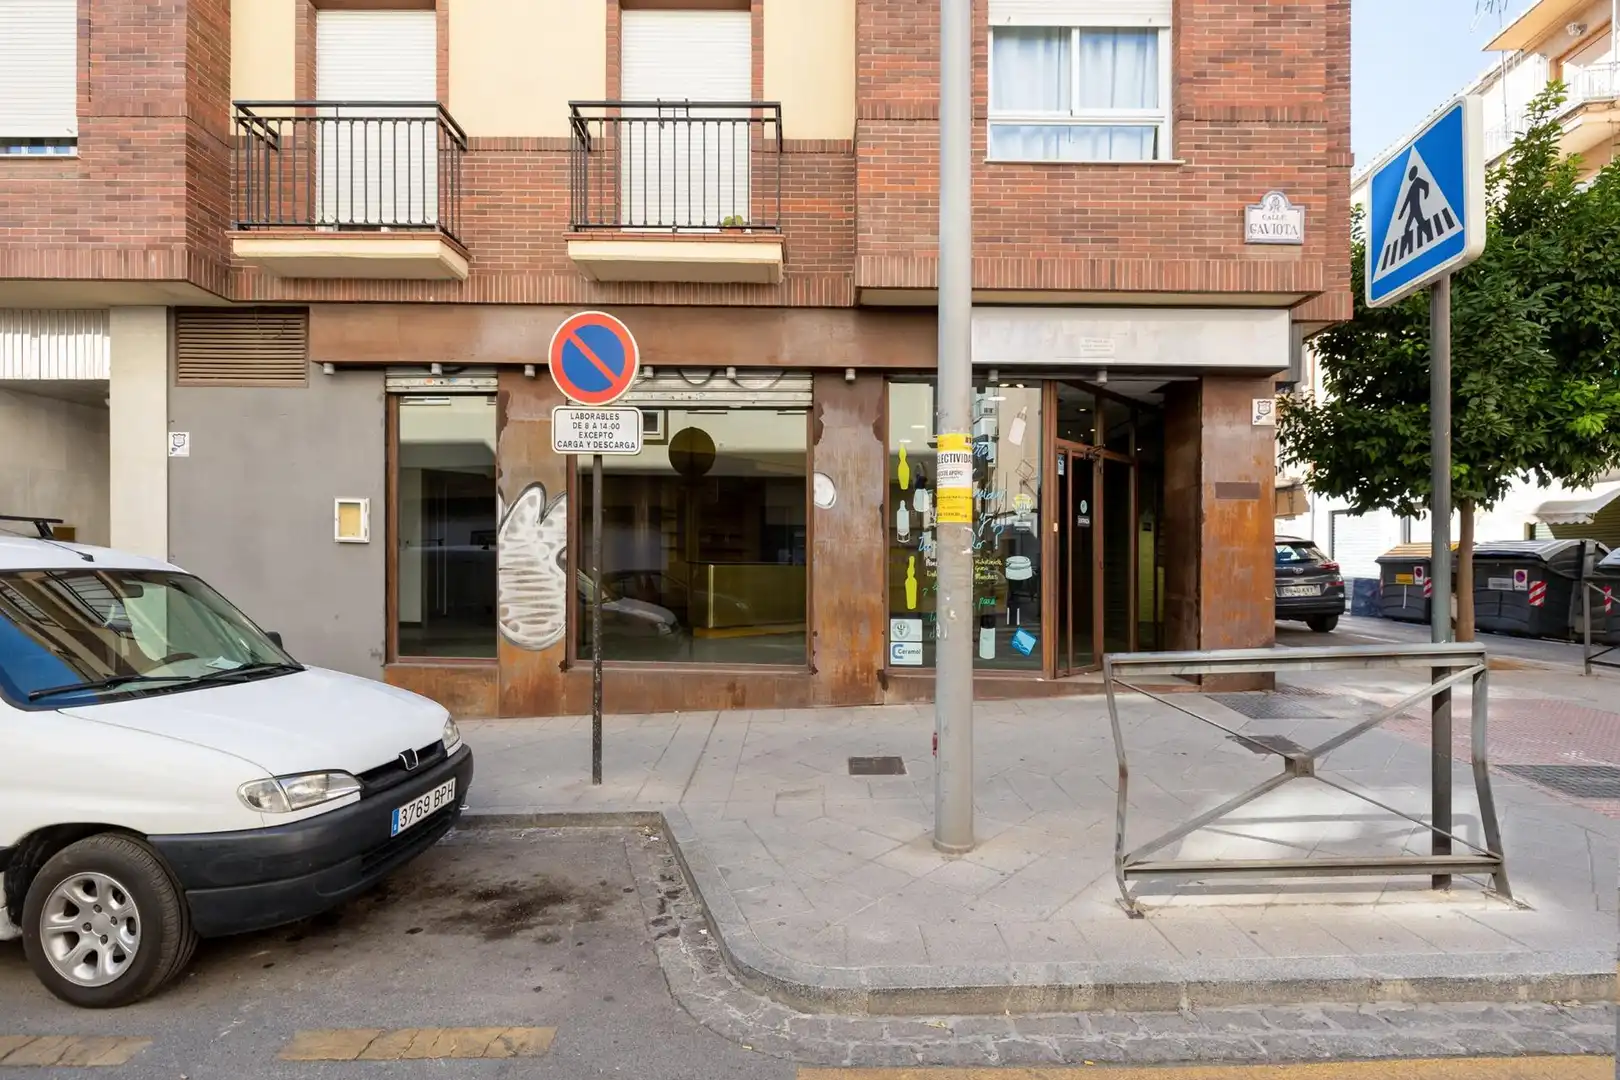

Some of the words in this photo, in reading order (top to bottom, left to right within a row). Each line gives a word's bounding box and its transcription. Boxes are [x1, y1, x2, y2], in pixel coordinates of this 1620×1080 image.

[1249, 223, 1298, 235] GAVIOTA
[570, 412, 620, 421] LABORABLES
[584, 422, 590, 430] 8
[592, 422, 598, 430] A
[578, 431, 614, 439] EXCEPTO
[557, 440, 584, 449] CARGA
[586, 440, 592, 448] Y
[593, 440, 636, 449] DESCARGA
[400, 795, 430, 828] 3769
[434, 780, 454, 808] BPH
